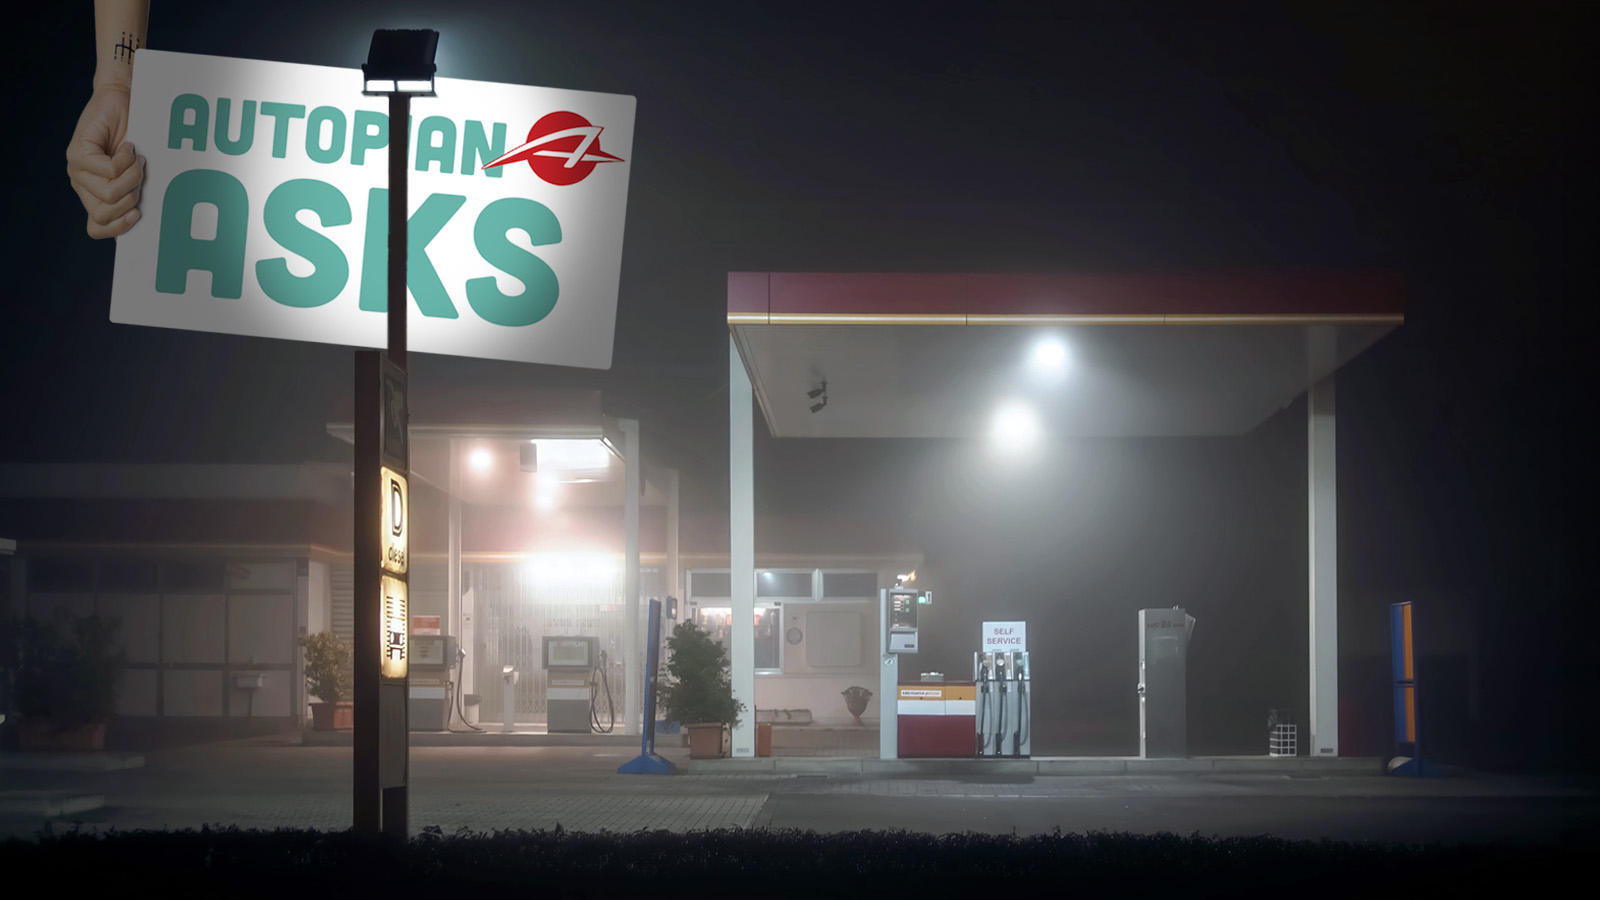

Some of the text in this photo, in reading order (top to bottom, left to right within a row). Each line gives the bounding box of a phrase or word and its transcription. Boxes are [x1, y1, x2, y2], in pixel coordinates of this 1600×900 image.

[156, 169, 563, 327] ASKS
[390, 478, 404, 537] D
[986, 636, 1022, 645] SERVICE
[993, 627, 1014, 636] SELF
